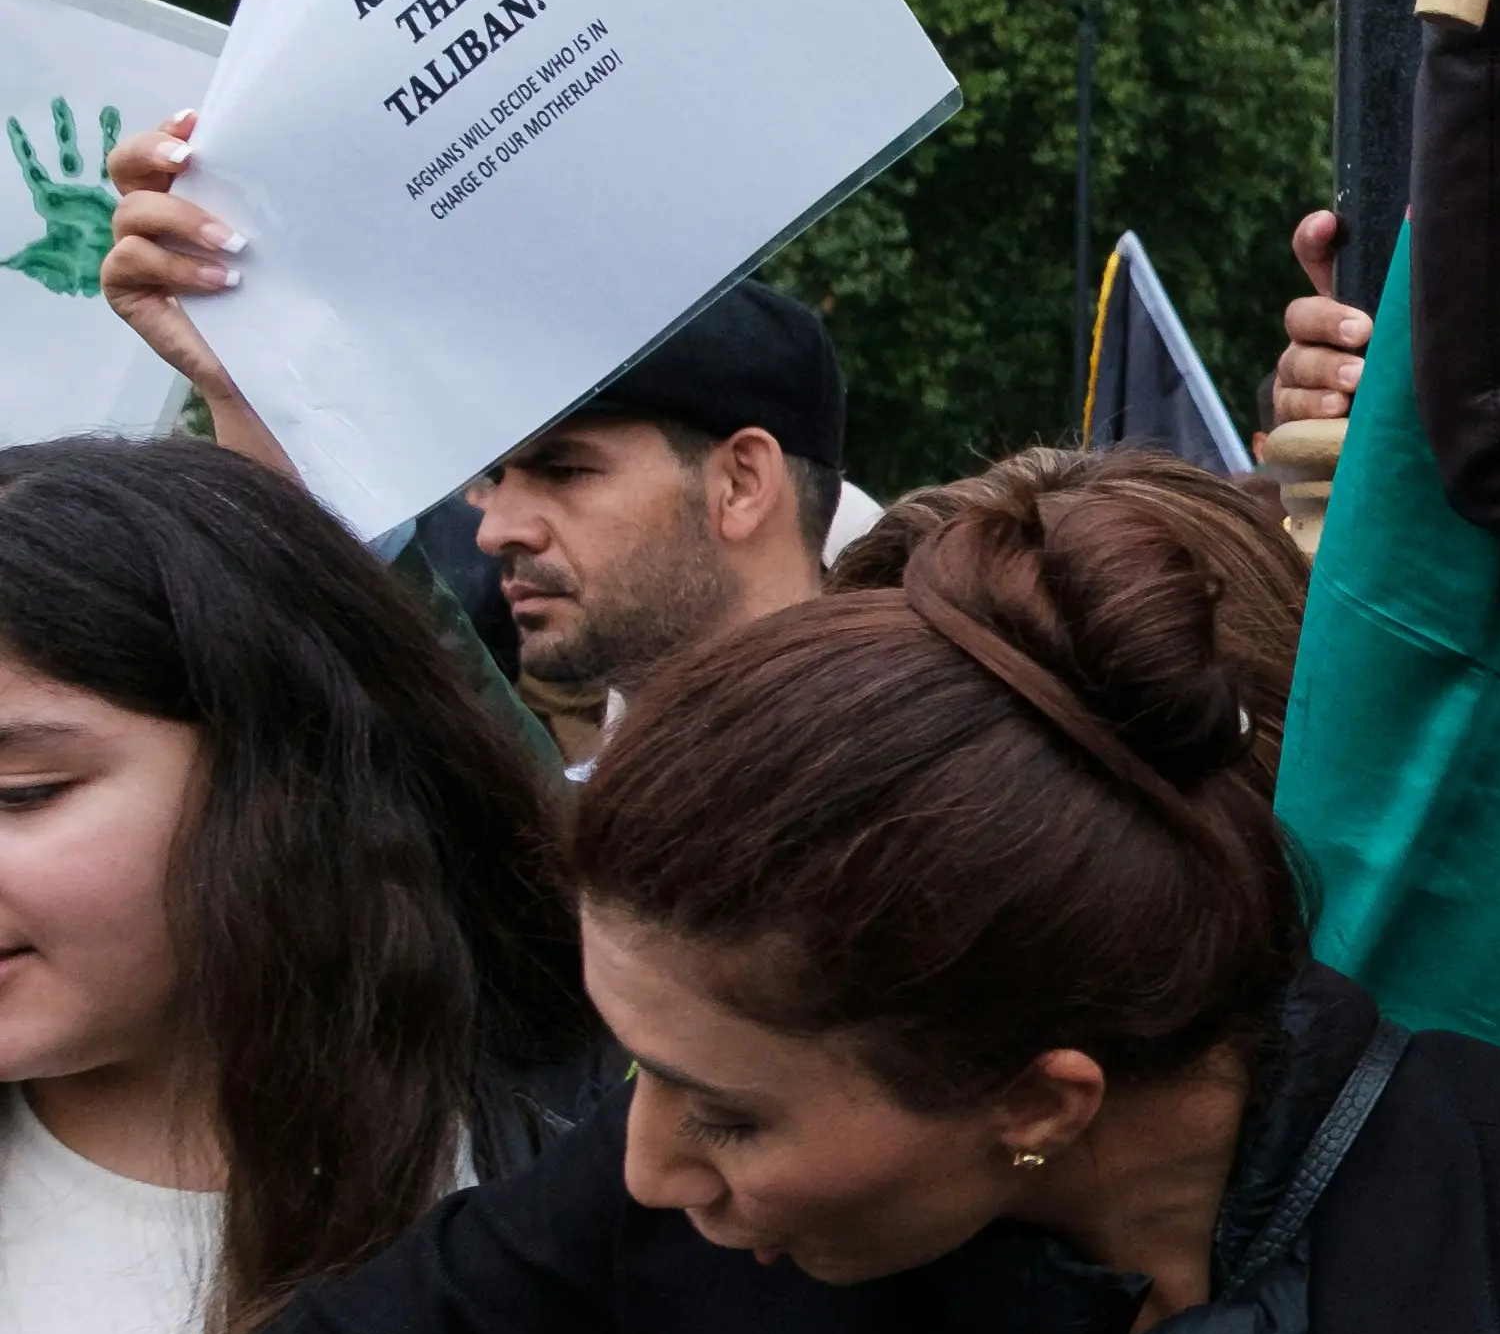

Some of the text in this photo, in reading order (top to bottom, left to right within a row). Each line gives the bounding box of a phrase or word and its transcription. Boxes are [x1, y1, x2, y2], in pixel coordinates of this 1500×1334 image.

[405, 18, 609, 200] AFGHANS WILL DECIDE WHO IS IN
[430, 47, 624, 220] CHARGE OF OUR MOTHERLAND!
